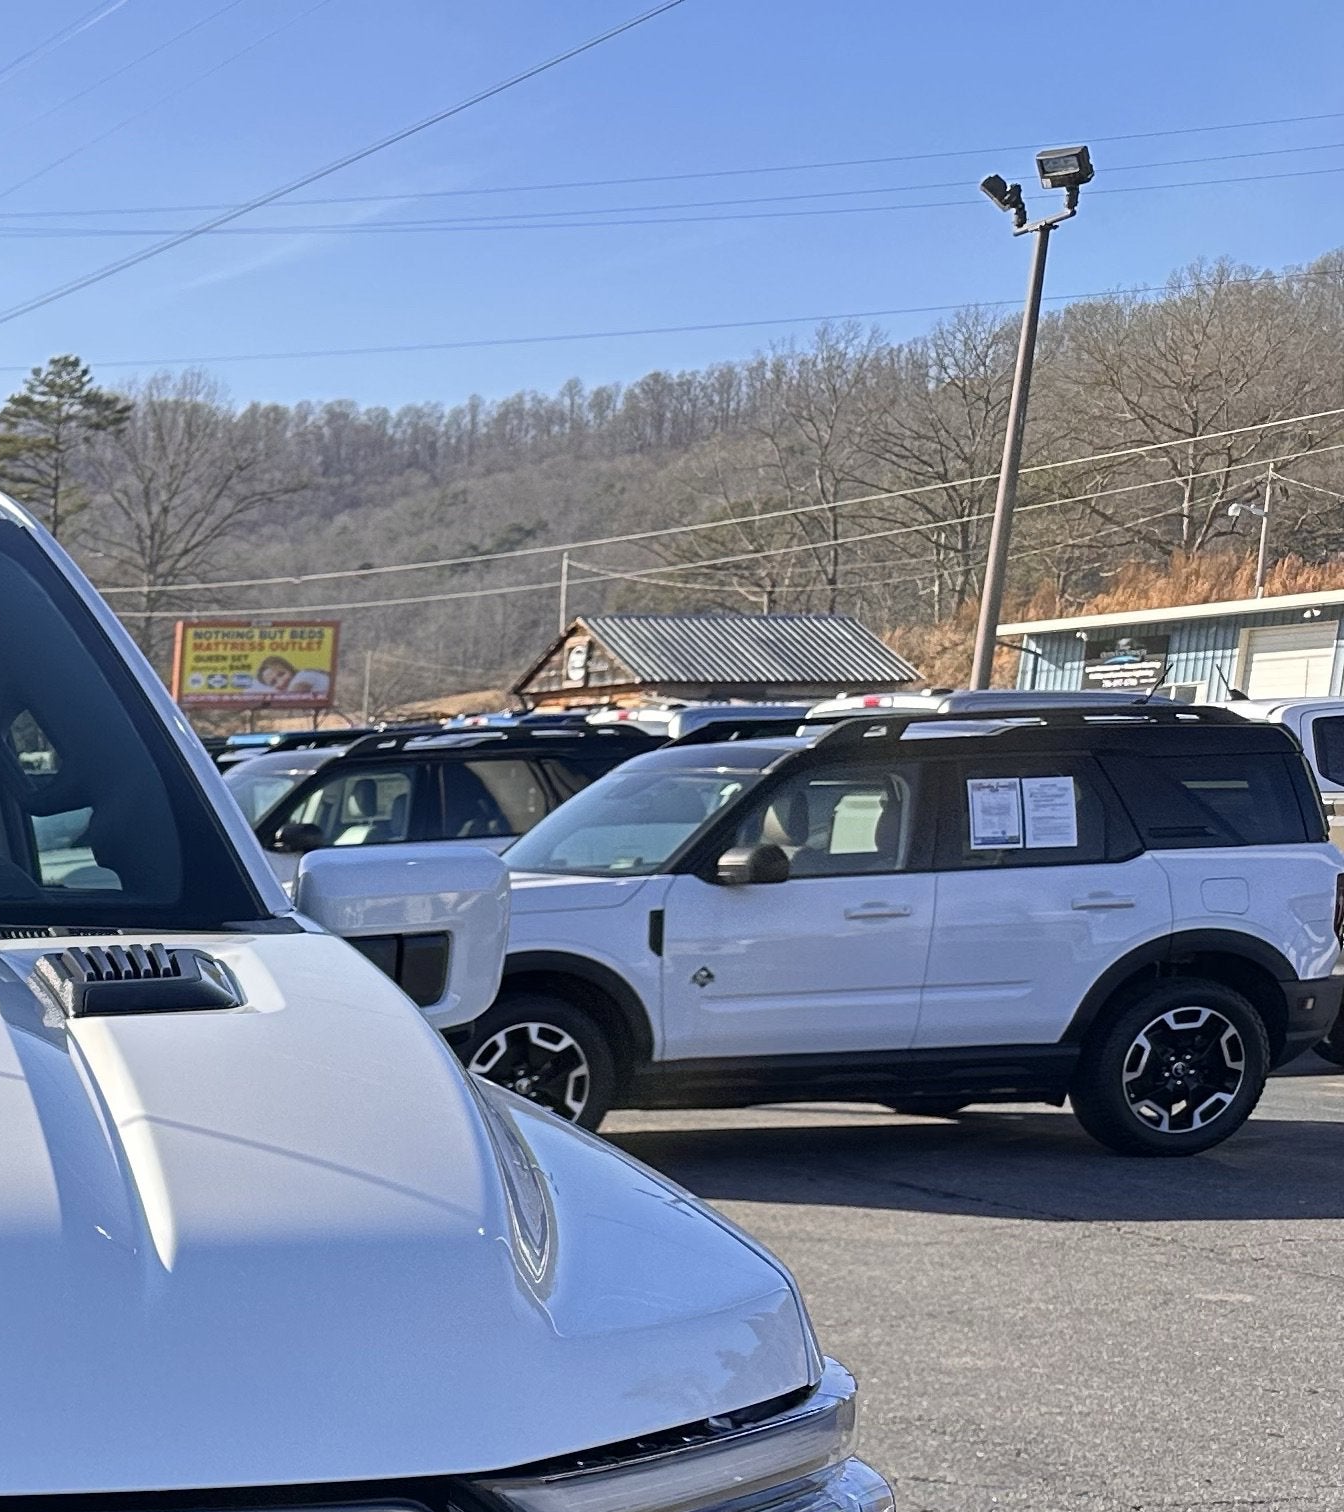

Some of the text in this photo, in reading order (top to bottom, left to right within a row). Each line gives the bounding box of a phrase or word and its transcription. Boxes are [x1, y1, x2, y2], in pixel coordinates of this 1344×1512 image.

[193, 629, 325, 641] NOTHING BUT BEDS
[191, 641, 322, 652] MATTRESS OUTLET
